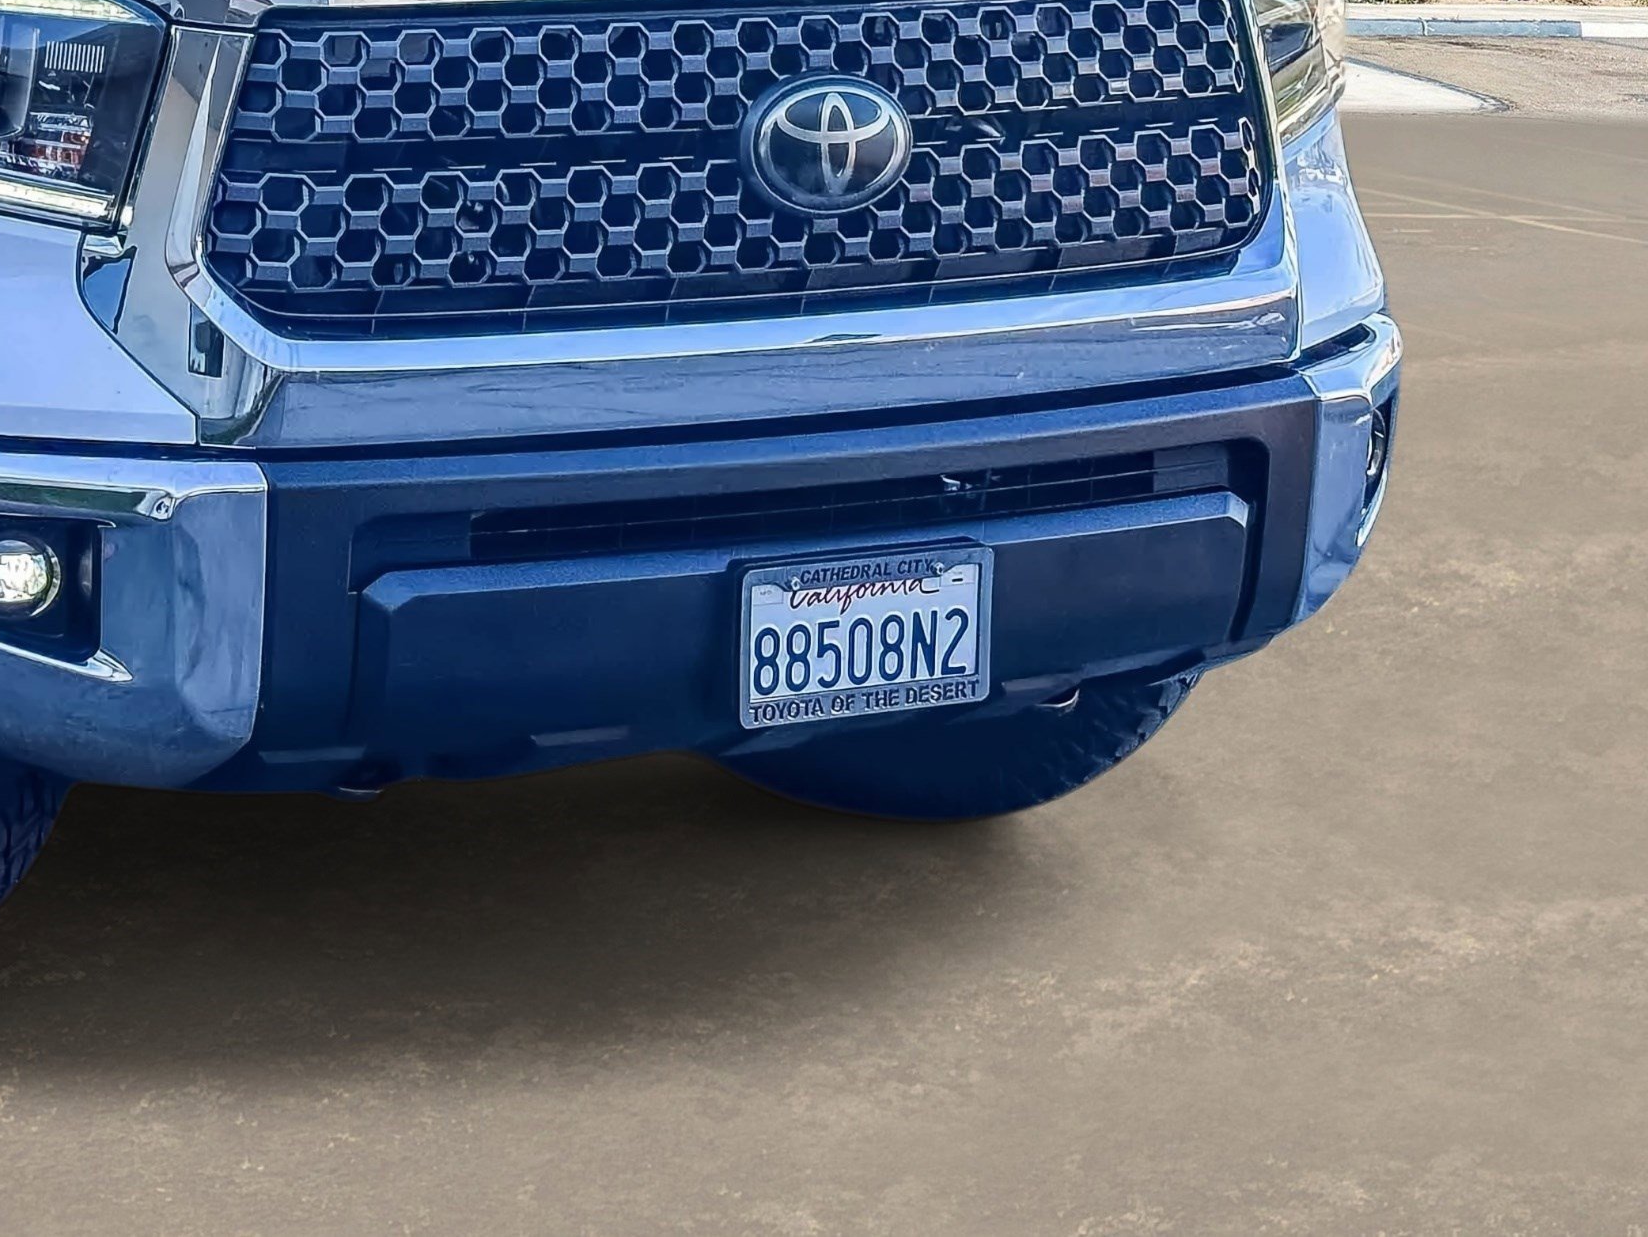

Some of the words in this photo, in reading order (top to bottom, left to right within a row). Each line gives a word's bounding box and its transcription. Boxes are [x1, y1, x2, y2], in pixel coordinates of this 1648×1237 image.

[800, 562, 891, 584] CATHEDRAL
[897, 558, 934, 575] CITY
[753, 608, 969, 696] 88508N2
[750, 697, 824, 724] TOYOTA
[831, 694, 856, 714] OF
[861, 688, 900, 711] THE
[905, 679, 980, 705] DESERT
